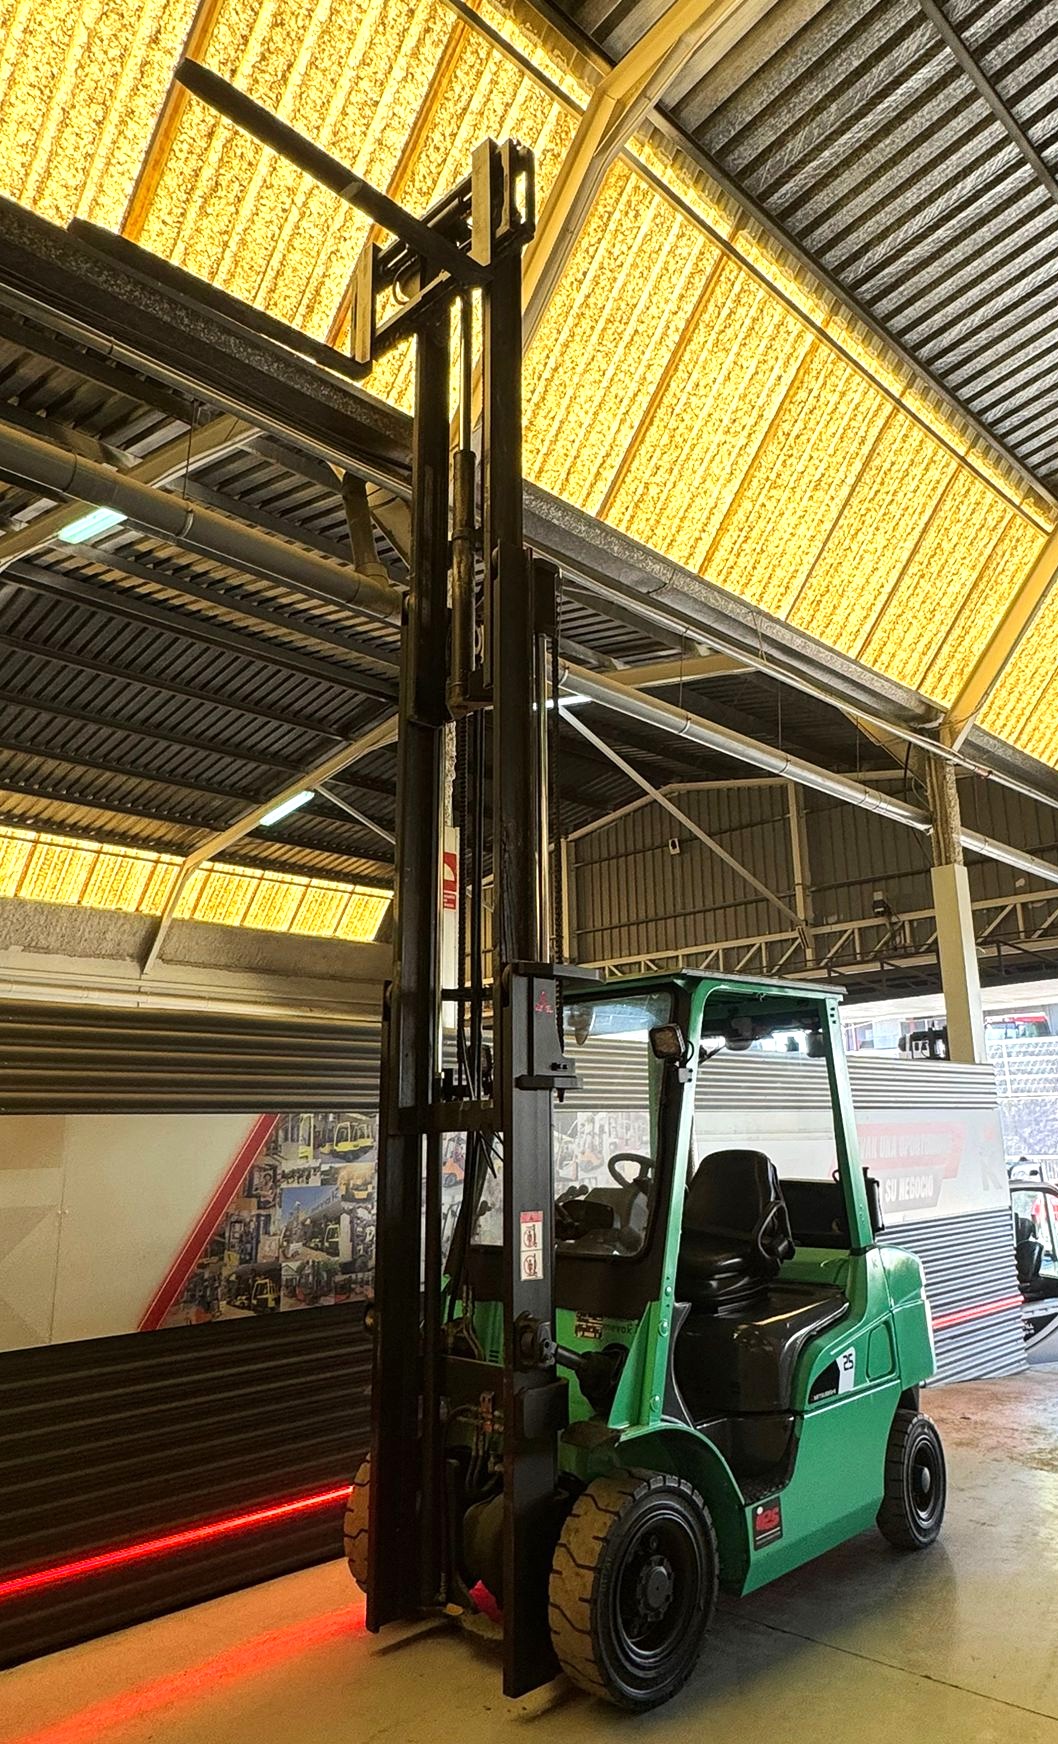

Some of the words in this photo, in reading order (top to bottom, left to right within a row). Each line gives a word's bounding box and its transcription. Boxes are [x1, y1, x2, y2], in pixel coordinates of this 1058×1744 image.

[885, 1178, 897, 1203] SU
[899, 1175, 934, 1201] NEGOCIO
[843, 1353, 854, 1371] 25
